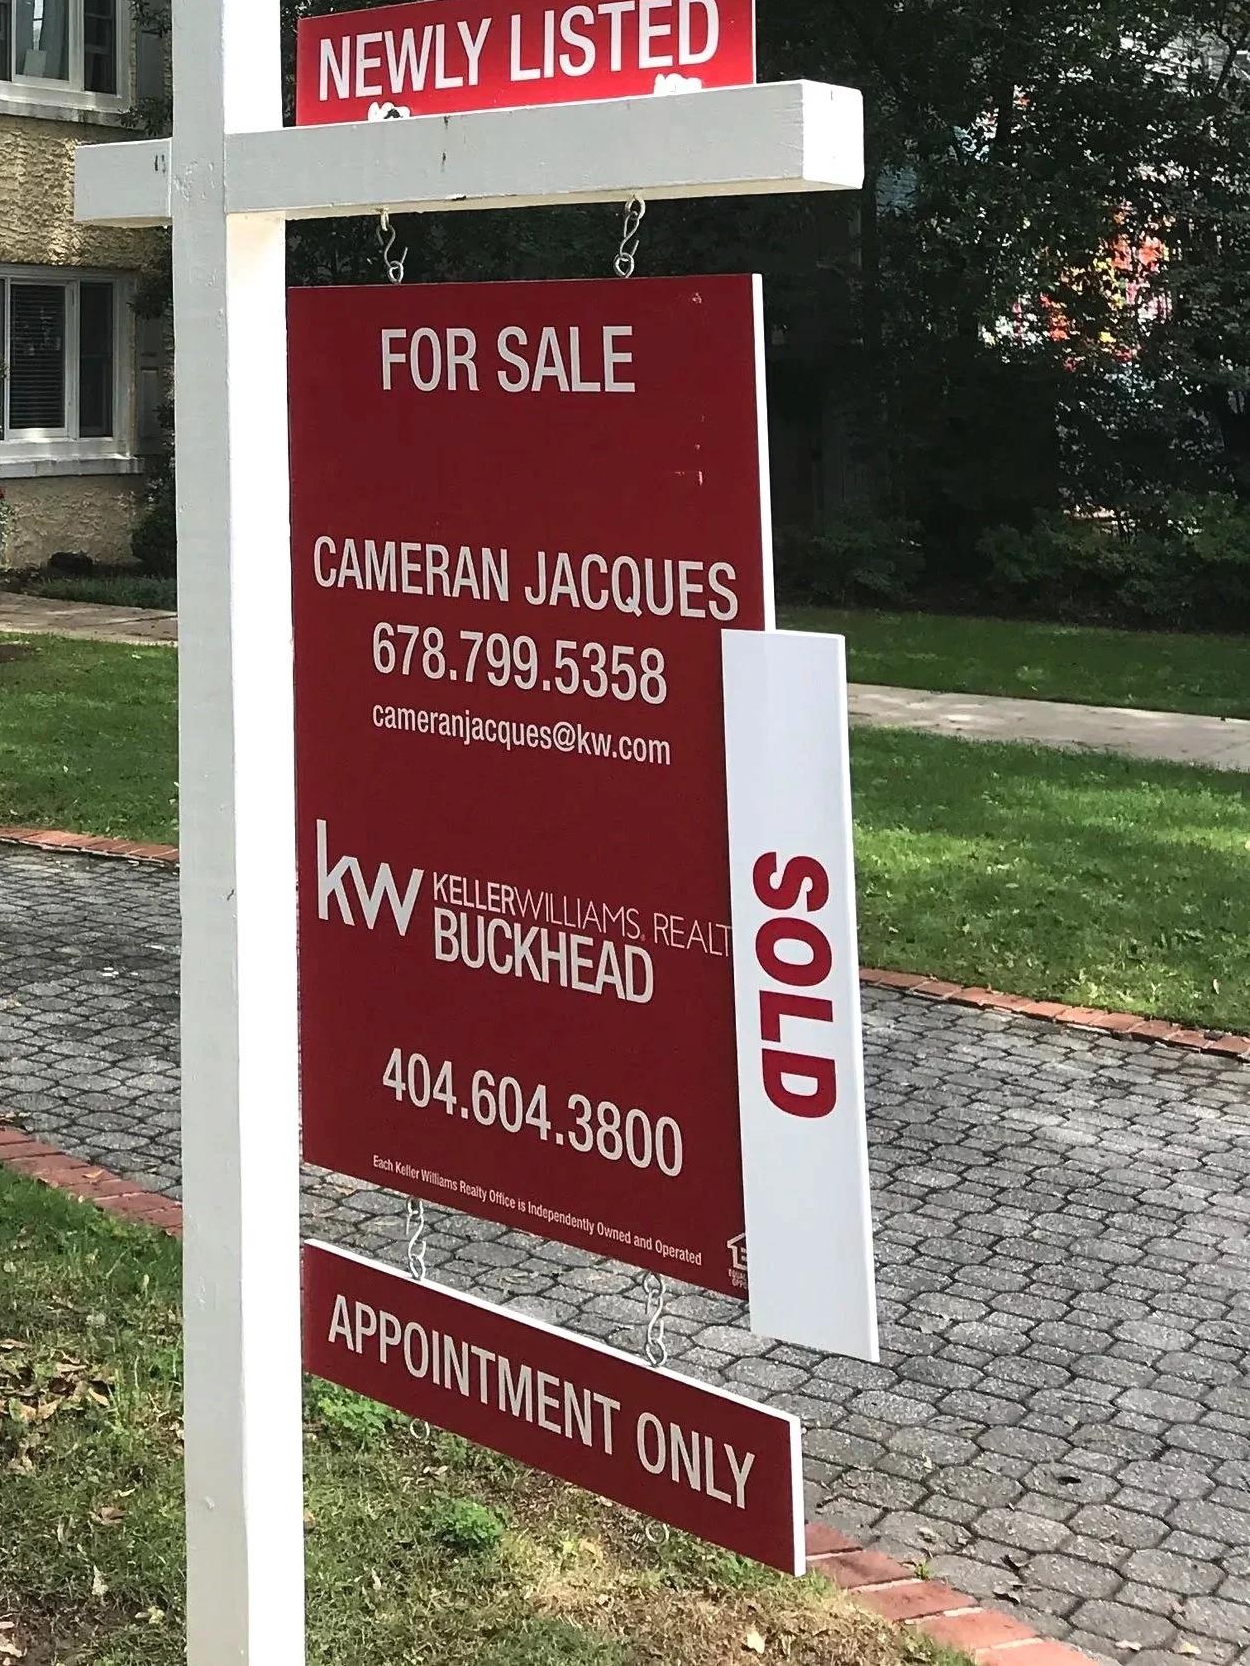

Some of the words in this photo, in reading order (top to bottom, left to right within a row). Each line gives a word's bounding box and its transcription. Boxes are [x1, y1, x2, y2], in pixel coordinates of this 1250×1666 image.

[320, 18, 491, 101] NEWLY
[382, 328, 479, 391] FOR
[498, 326, 635, 392] SALE
[314, 536, 508, 601] CAMERAN
[525, 552, 738, 620] JACQUES
[373, 622, 666, 704] 678.799.5358
[373, 703, 670, 765] cameranjacques@kw.com
[317, 819, 424, 936] kw
[434, 907, 654, 1003] BUCKHEAD
[654, 913, 732, 956] REALT
[752, 851, 837, 1118] SOLD
[383, 1048, 682, 1176] 404.604.3800
[373, 1155, 394, 1172] Each
[395, 1161, 420, 1180] Keller
[421, 1169, 458, 1191] Williams
[459, 1180, 487, 1202] Realty
[489, 1189, 516, 1209] Office
[517, 1198, 526, 1212] is
[528, 1201, 595, 1236] Independently
[597, 1222, 631, 1244] Owned
[634, 1234, 652, 1250] and
[655, 1240, 702, 1266] Operated
[329, 1294, 620, 1454] APPOINTMENT
[637, 1412, 755, 1509] ONLY
